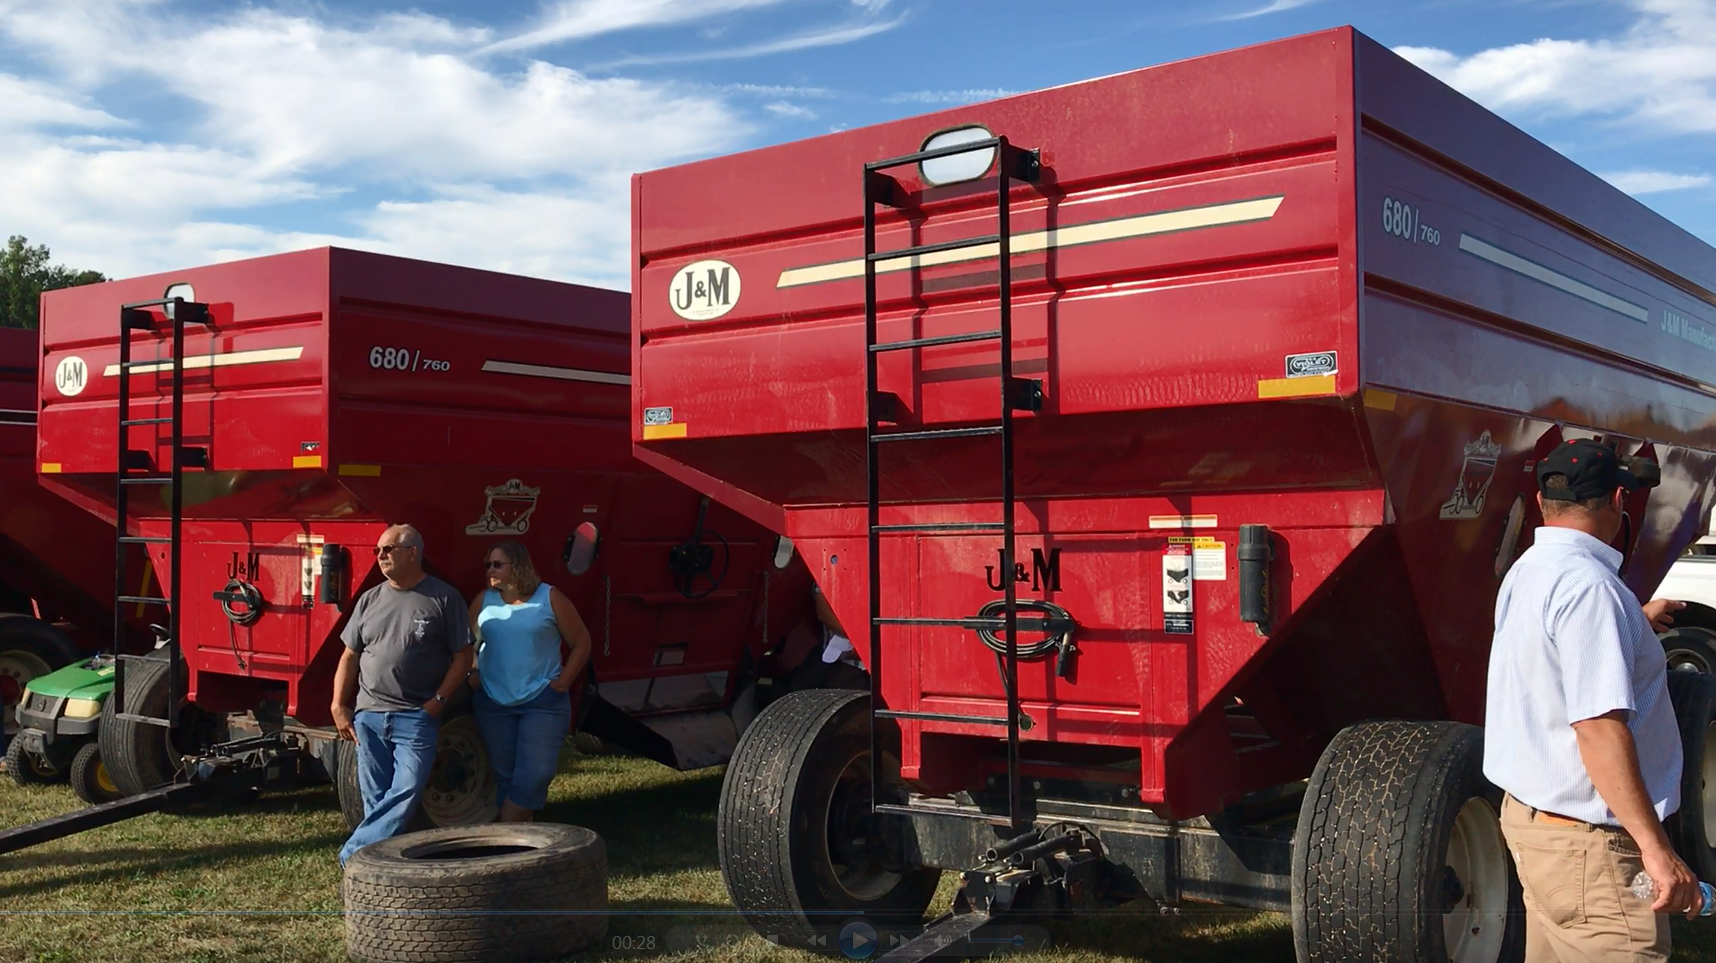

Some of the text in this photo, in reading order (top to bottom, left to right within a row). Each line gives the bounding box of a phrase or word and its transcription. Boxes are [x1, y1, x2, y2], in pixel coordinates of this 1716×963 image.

[674, 266, 731, 311] J&M
[58, 361, 83, 389] J&M
[226, 551, 260, 582] J&M
[985, 547, 1063, 592] J&M
